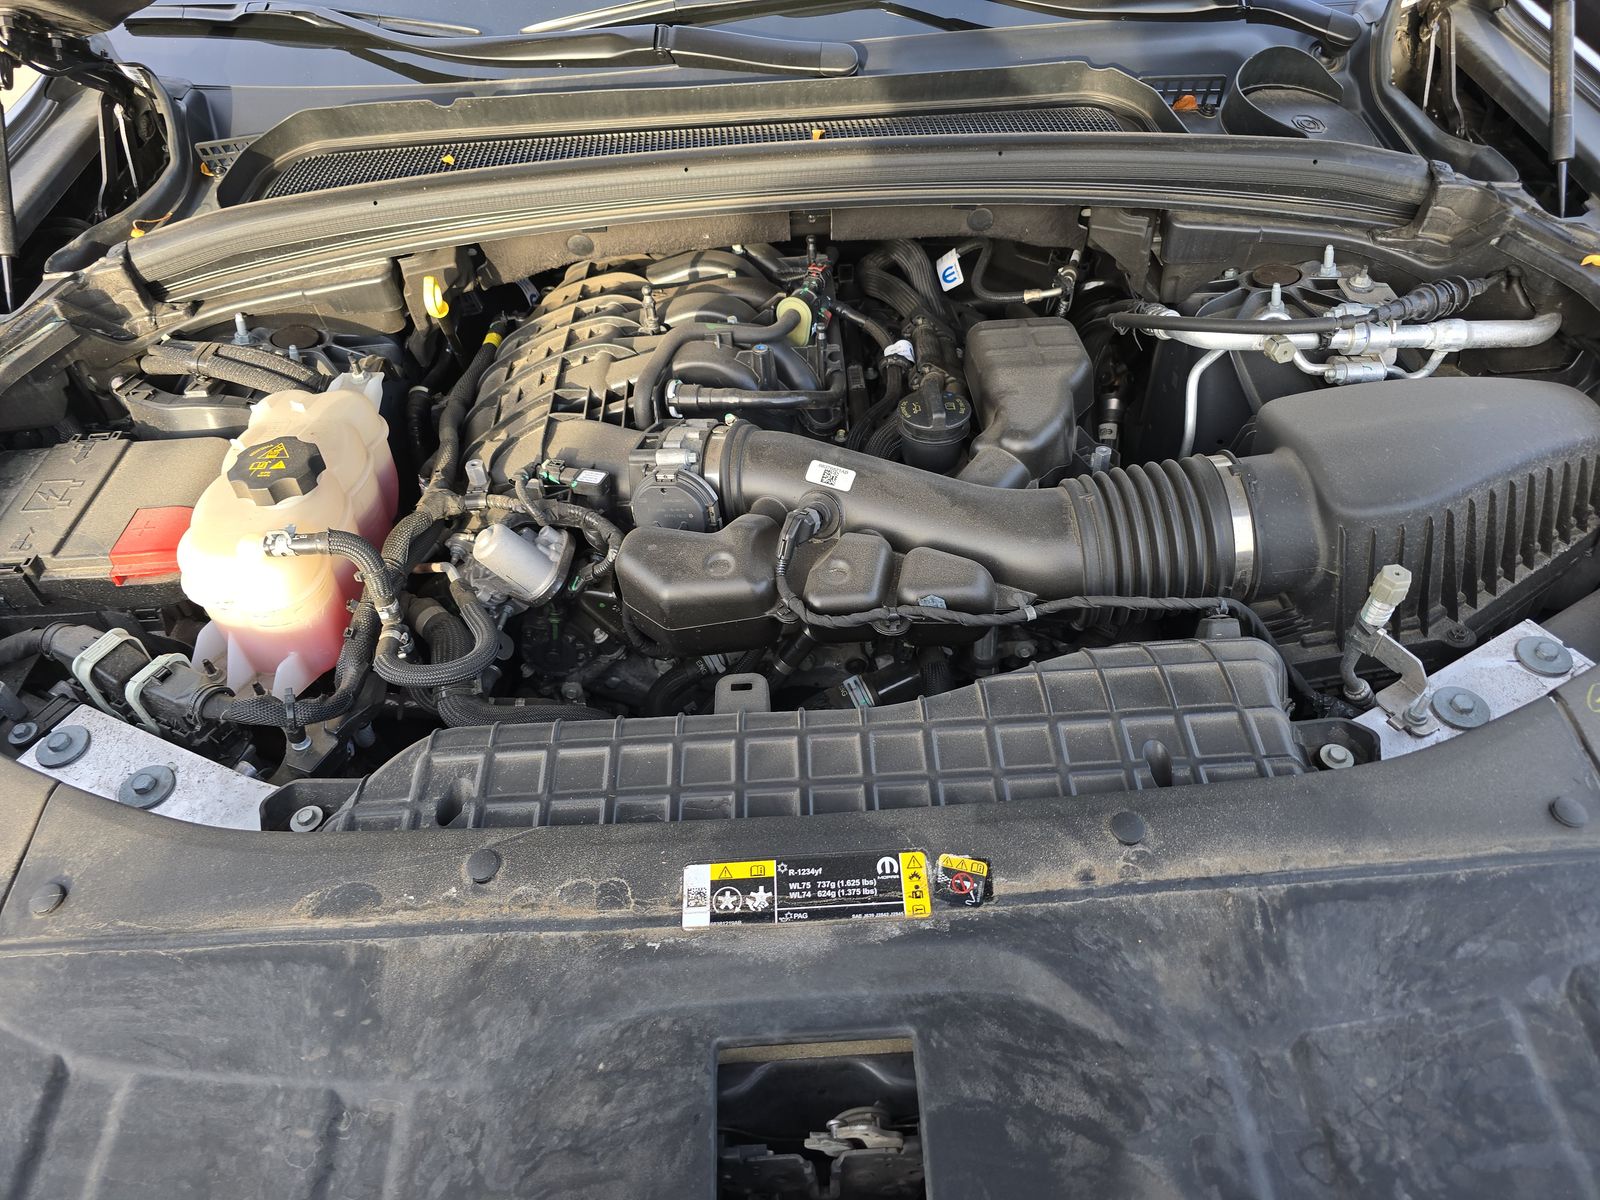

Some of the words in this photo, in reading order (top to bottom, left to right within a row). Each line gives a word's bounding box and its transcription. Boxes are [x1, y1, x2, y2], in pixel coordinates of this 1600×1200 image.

[788, 867, 823, 876] R-1234yf
[788, 882, 812, 890] WL75
[816, 881, 836, 889] 737g
[837, 880, 860, 888] (1.625
[861, 878, 877, 887] lbs)
[789, 890, 812, 899] WL74
[817, 890, 836, 898] 624g
[837, 889, 861, 897] (1.375
[862, 887, 878, 896] lbs)
